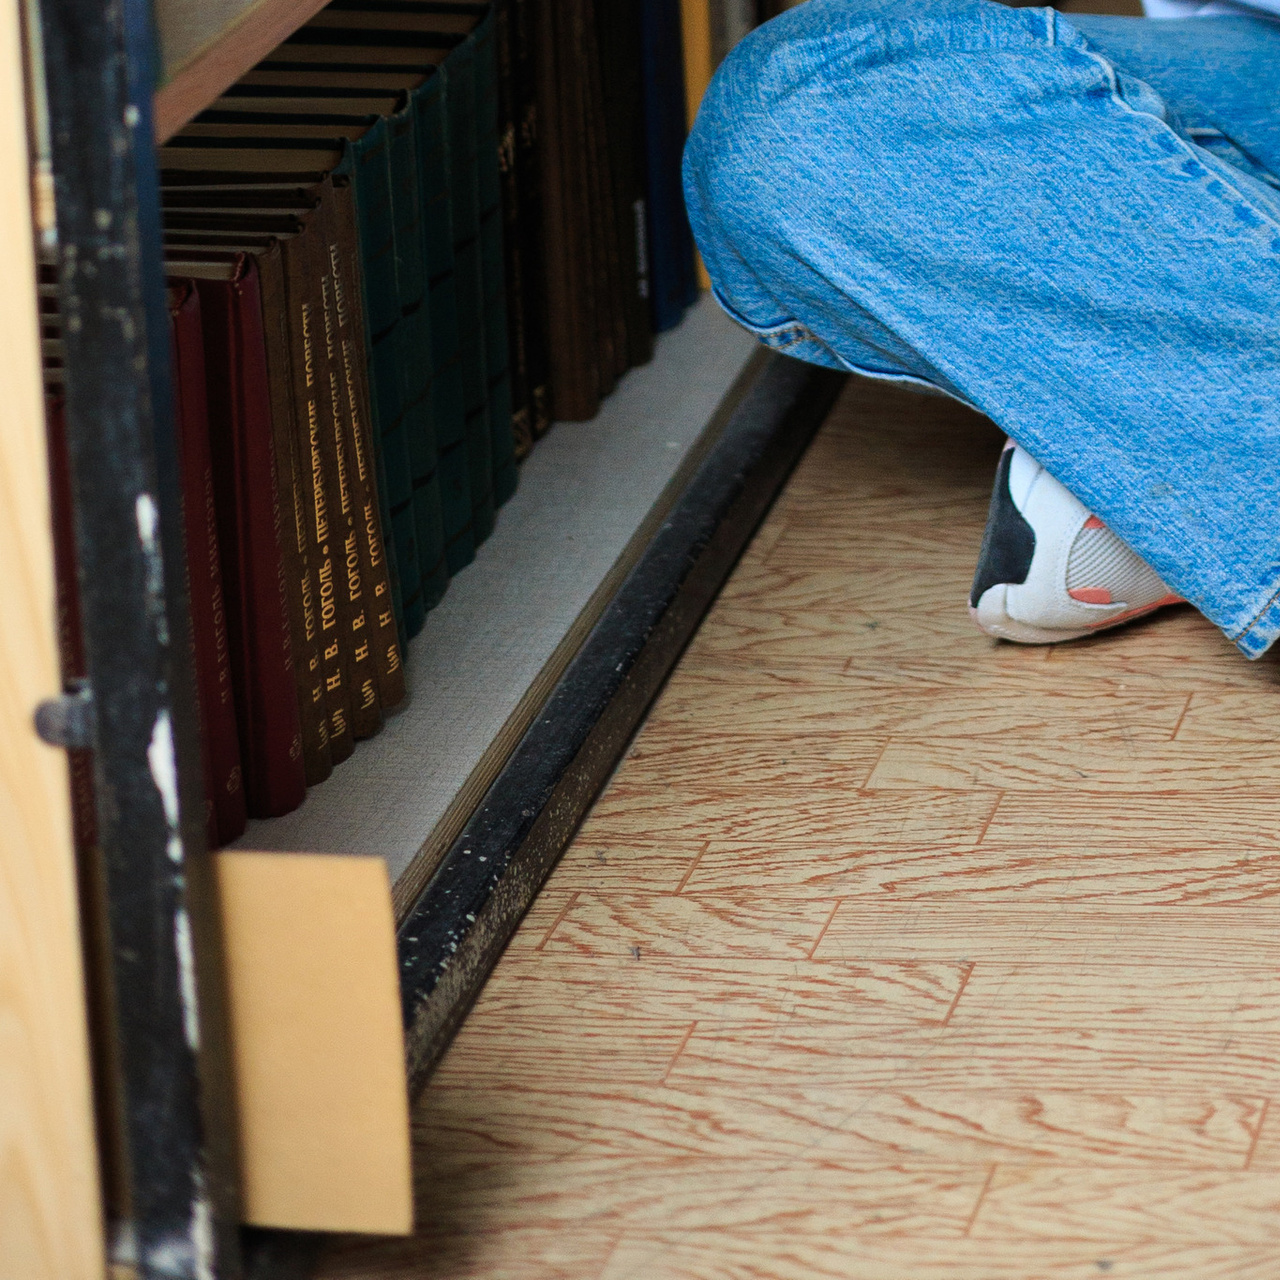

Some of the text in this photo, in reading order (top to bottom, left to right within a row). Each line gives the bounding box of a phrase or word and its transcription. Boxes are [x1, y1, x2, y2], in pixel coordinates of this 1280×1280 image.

[344, 529, 363, 602] ГОГОЛЬ
[318, 558, 337, 631] ГОГОЛЬ
[351, 608, 366, 632] В.
[323, 637, 339, 661] В.
[354, 639, 369, 663] Н.
[326, 667, 342, 692] Н.
